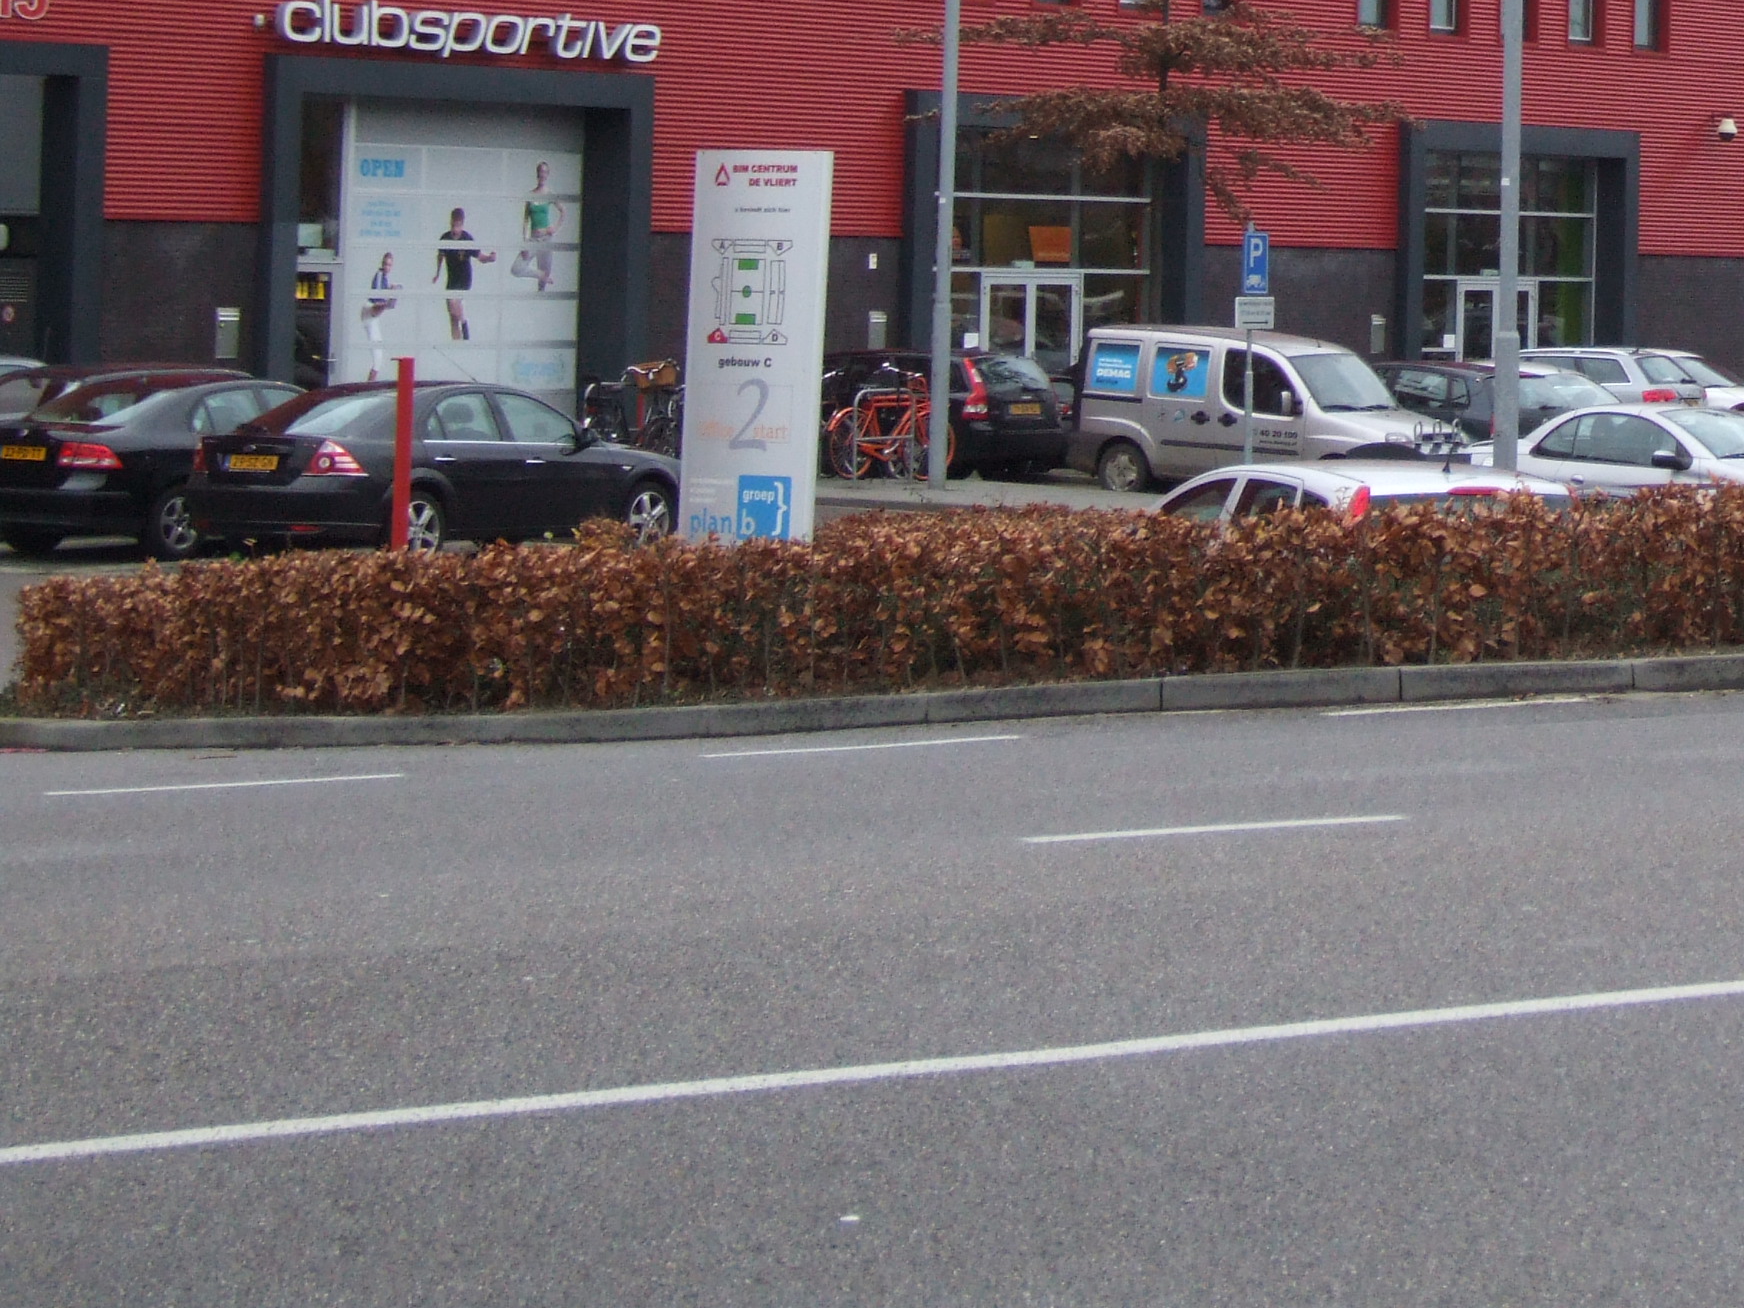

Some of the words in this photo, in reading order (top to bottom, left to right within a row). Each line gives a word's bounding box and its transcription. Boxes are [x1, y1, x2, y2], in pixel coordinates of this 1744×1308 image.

[360, 159, 405, 178] OPEN
[751, 165, 798, 173] CENTRUM
[749, 178, 760, 187] DE
[763, 178, 797, 187] VLIERT
[1250, 238, 1263, 268] P
[718, 356, 760, 368] gebouw
[764, 358, 772, 367] C
[743, 489, 775, 504] groep
[690, 508, 732, 539] plan
[740, 509, 756, 535] b
